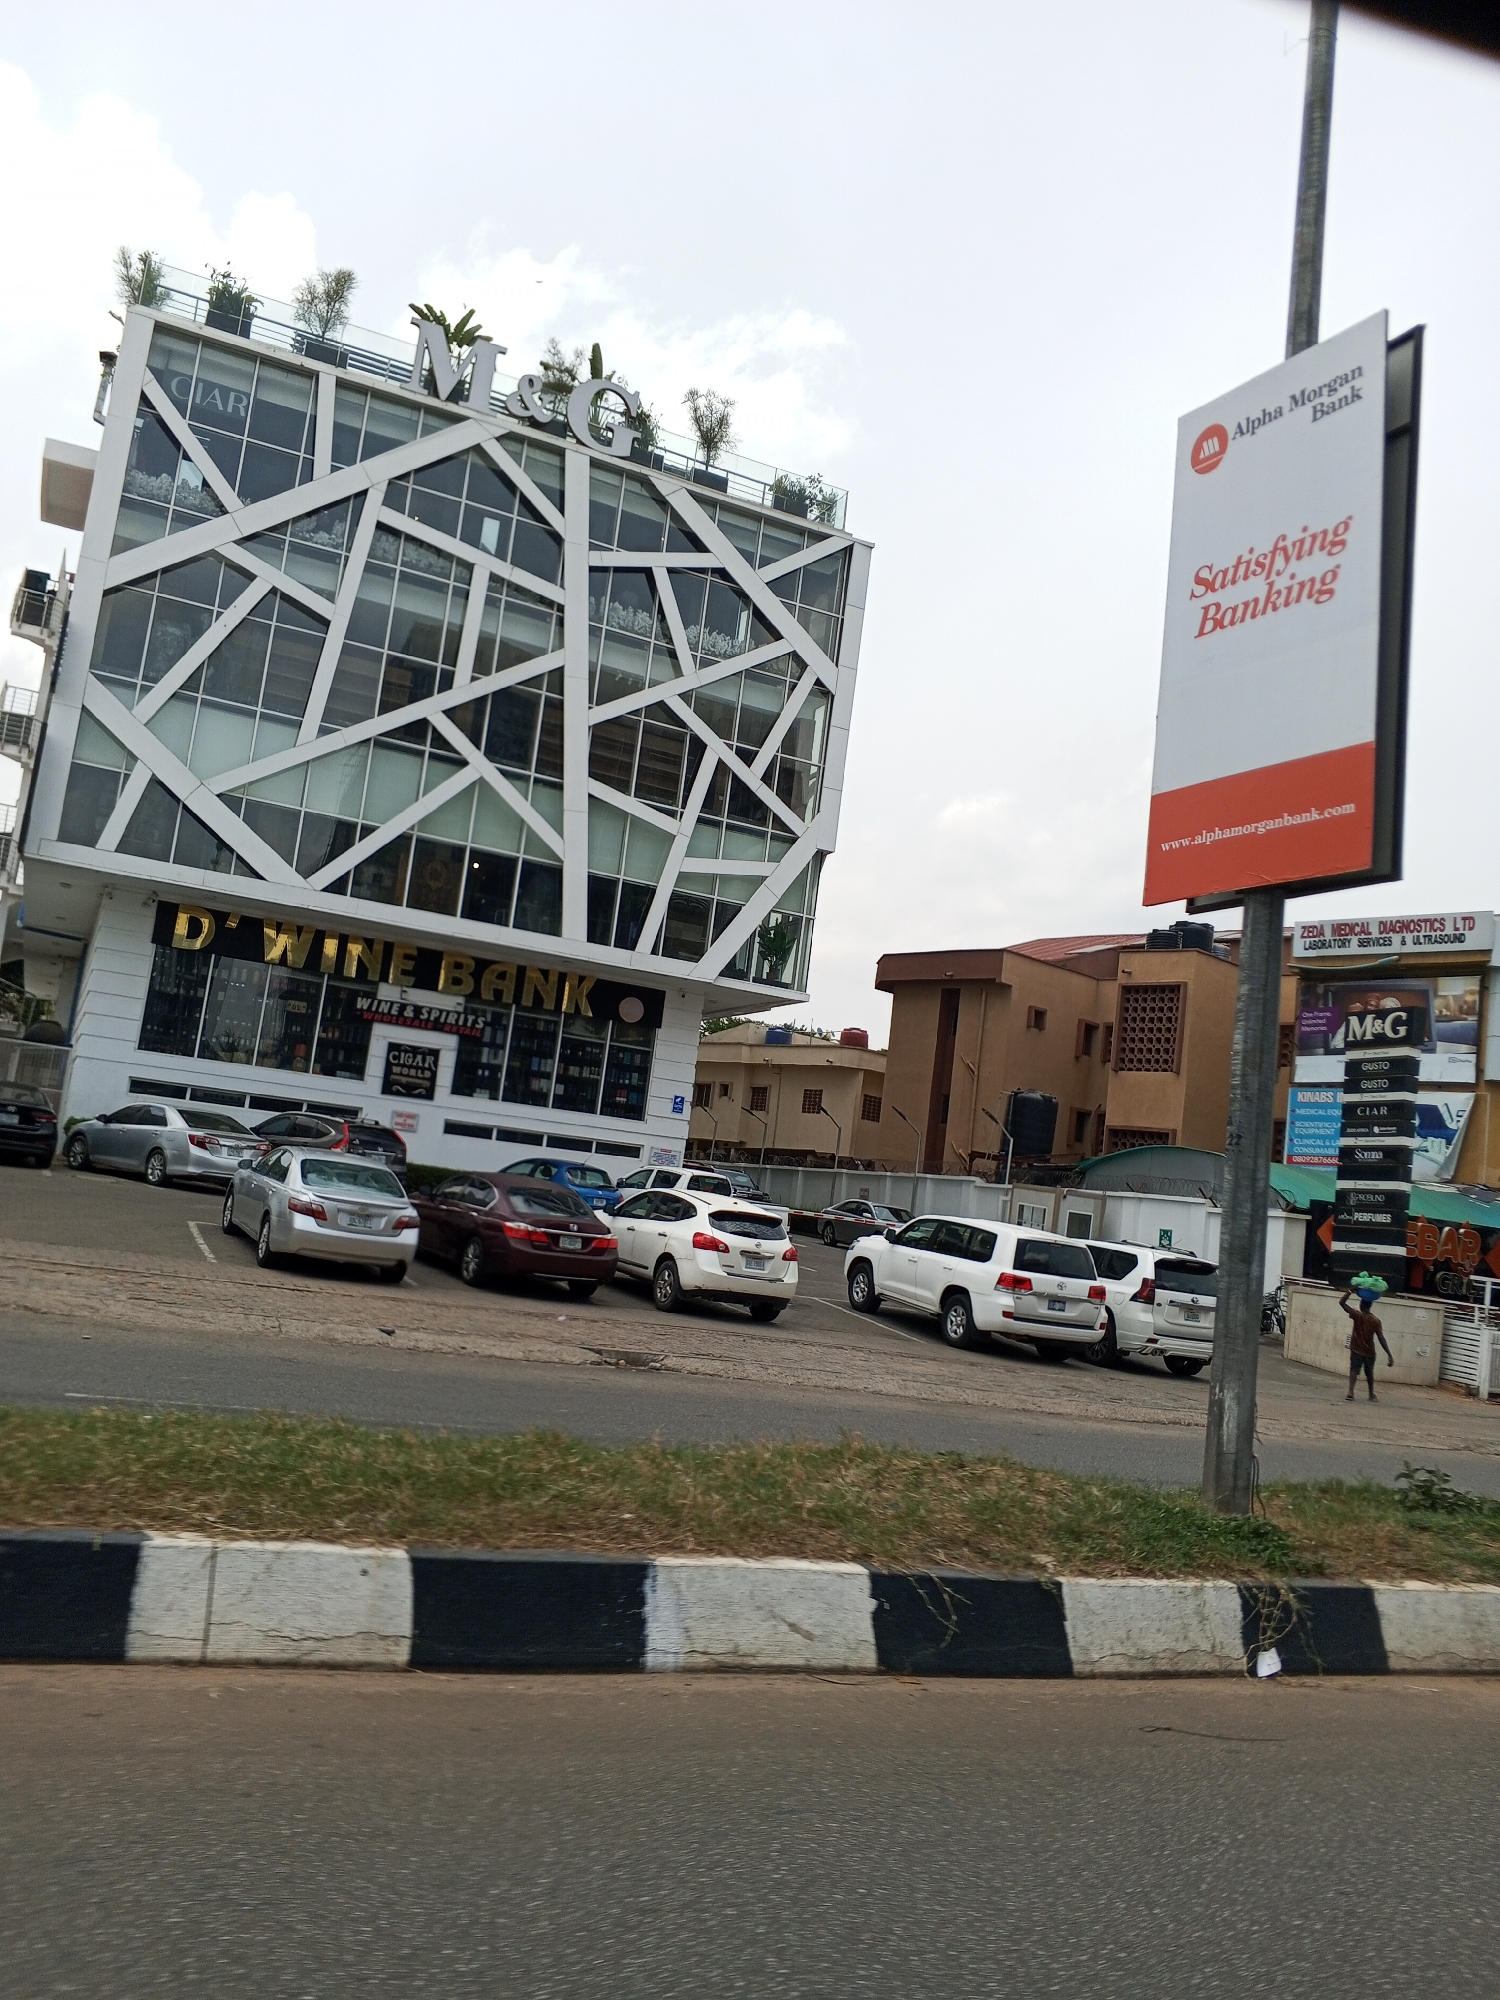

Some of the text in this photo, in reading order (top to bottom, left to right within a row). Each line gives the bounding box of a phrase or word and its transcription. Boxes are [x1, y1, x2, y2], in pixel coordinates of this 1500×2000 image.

[171, 376, 248, 417] CIAR
[1231, 365, 1364, 440] Alpha Morgan
[1311, 385, 1364, 423] Bank
[1190, 515, 1354, 601] Satisfying
[1194, 564, 1341, 639] Banking
[1160, 802, 1356, 852] www.alphamorganbank.com
[1300, 915, 1475, 939] ZEDA MEDICAL DIAGNOSTICS LTD
[1304, 933, 1466, 951] LABORATORY SERVICES & ULTRASOUND
[437, 951, 599, 1018] BANK
[356, 996, 486, 1029] WINE & SPIRITS
[1346, 1011, 1408, 1041] M&G
[389, 1051, 437, 1071] CIGAR
[391, 1065, 432, 1078] WORLD
[1361, 1061, 1390, 1071] GUSTO
[1297, 1091, 1334, 1103] KINABS
[1360, 1079, 1389, 1089] GUSTO
[1357, 1106, 1388, 1116] CIAR
[1354, 1212, 1392, 1223] PERFUMES
